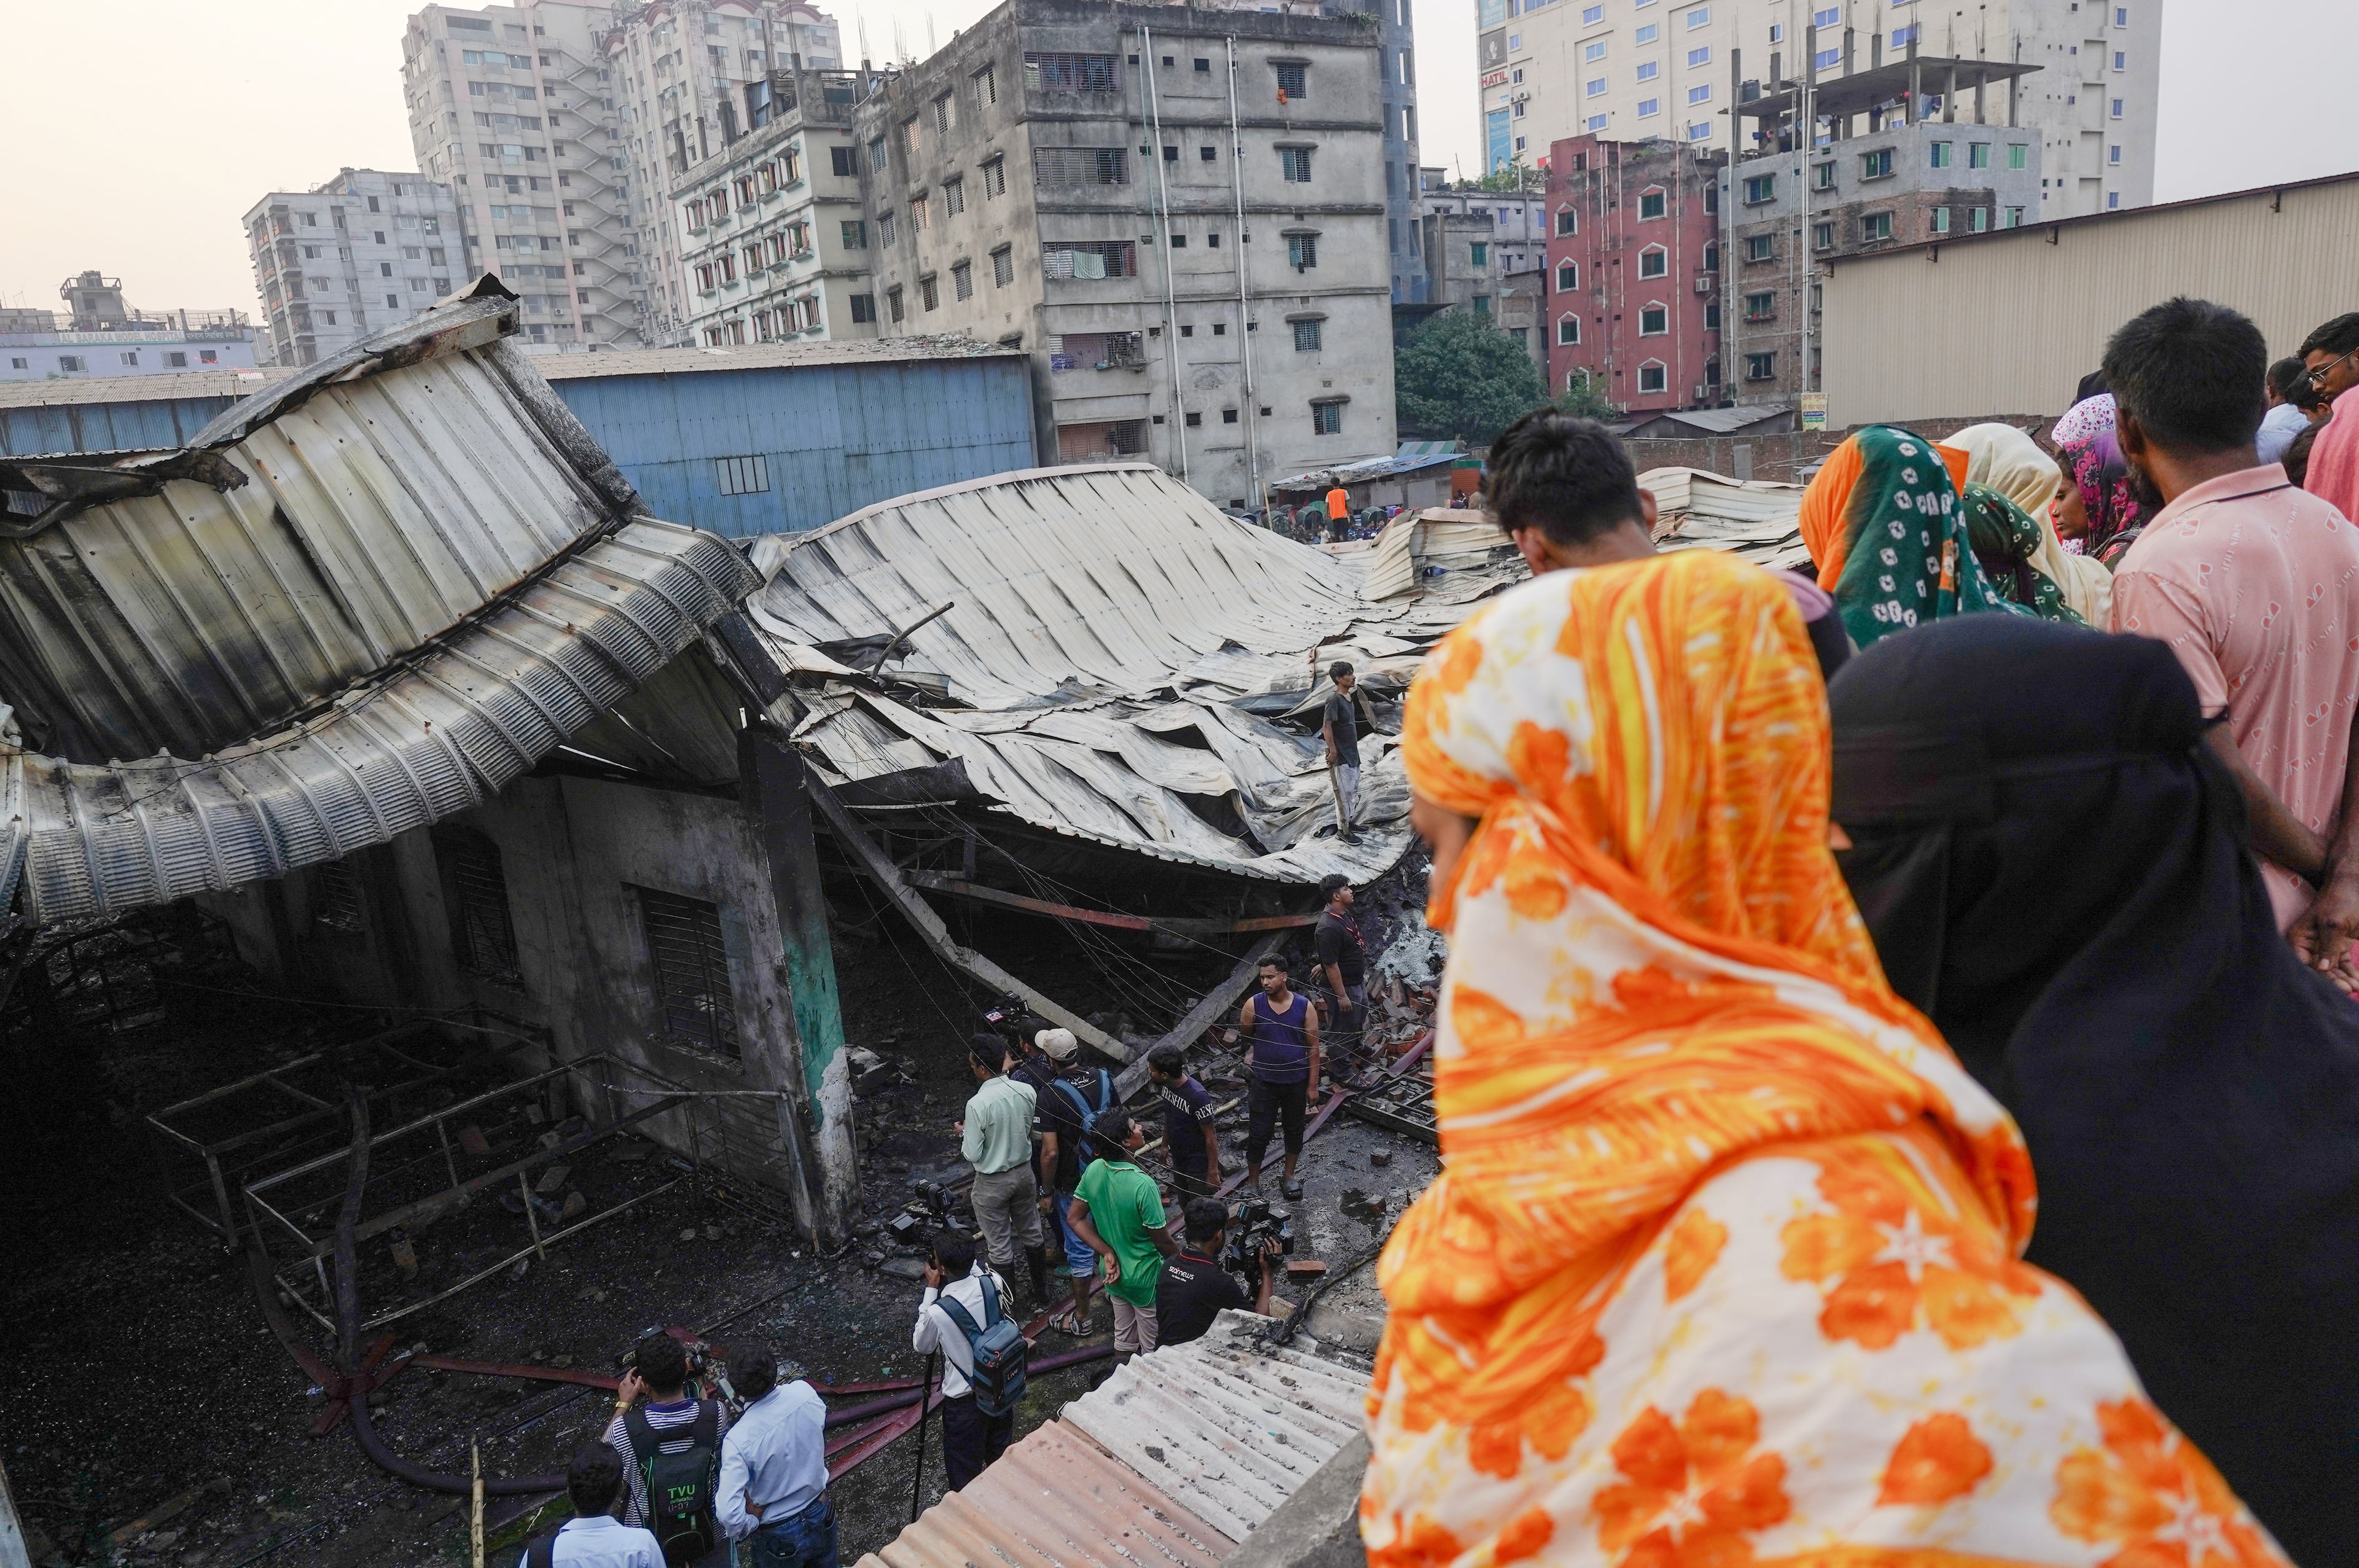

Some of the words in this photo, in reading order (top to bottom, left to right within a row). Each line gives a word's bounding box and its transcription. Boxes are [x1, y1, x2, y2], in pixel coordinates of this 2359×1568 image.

[1481, 71, 1508, 87] HATIL
[61, 332, 74, 342] AL
[76, 332, 114, 342] BARAKA
[115, 332, 143, 341] MODEL
[144, 330, 184, 341] HOSPITAL
[667, 1484, 695, 1499] TVU
[670, 1496, 694, 1505] networks
